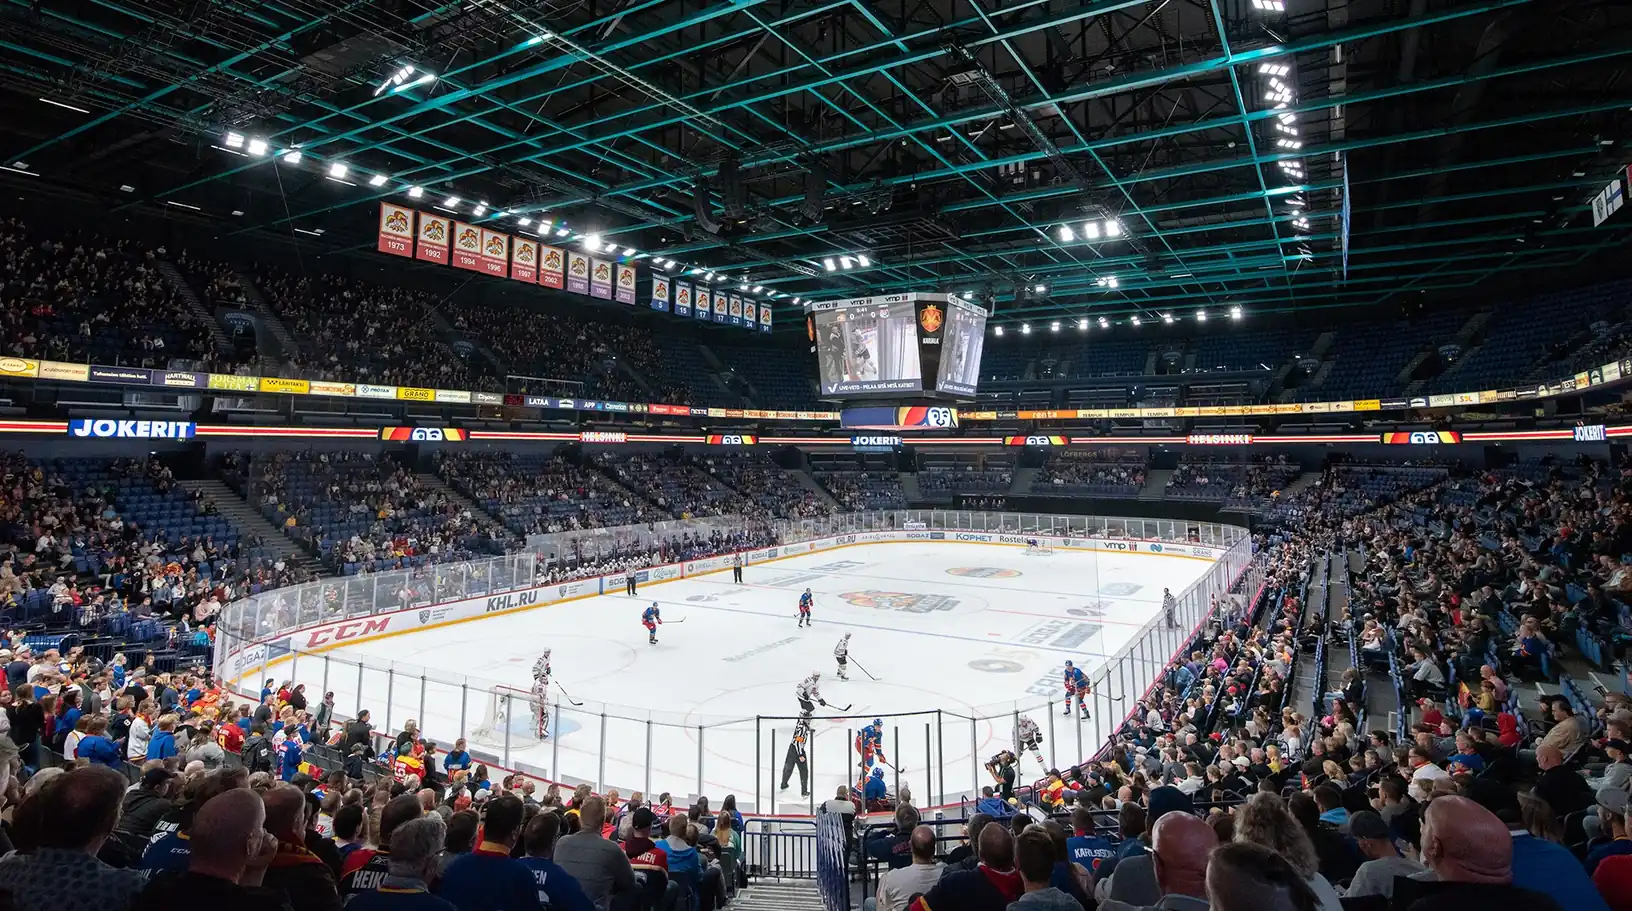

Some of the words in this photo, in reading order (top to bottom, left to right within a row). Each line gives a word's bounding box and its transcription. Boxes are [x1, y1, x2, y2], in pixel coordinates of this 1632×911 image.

[388, 241, 405, 251] 1973
[425, 249, 441, 259] 1992
[460, 256, 476, 265] 1994
[518, 269, 531, 278] 1997
[165, 373, 196, 382] HARTWALL
[209, 373, 260, 385] FORSMAN
[404, 390, 429, 398] GRANO
[529, 398, 549, 406] LATAA
[75, 419, 190, 438] JOKERIT
[1575, 424, 1605, 440] JOKERIT
[581, 432, 625, 442] HELSINKI
[853, 436, 900, 445] JOKERIT
[1189, 434, 1250, 444] HELSINKI
[1060, 450, 1098, 458] LÖFBERGS
[836, 534, 856, 545] KHL.RU
[1104, 541, 1126, 550] vmp
[751, 551, 767, 560] SOGAZ
[609, 578, 628, 586] SOGA
[486, 590, 538, 612] KHL.RU
[306, 617, 391, 648] CCM
[1074, 847, 1116, 859] KARLSSO
[531, 869, 547, 885] EN
